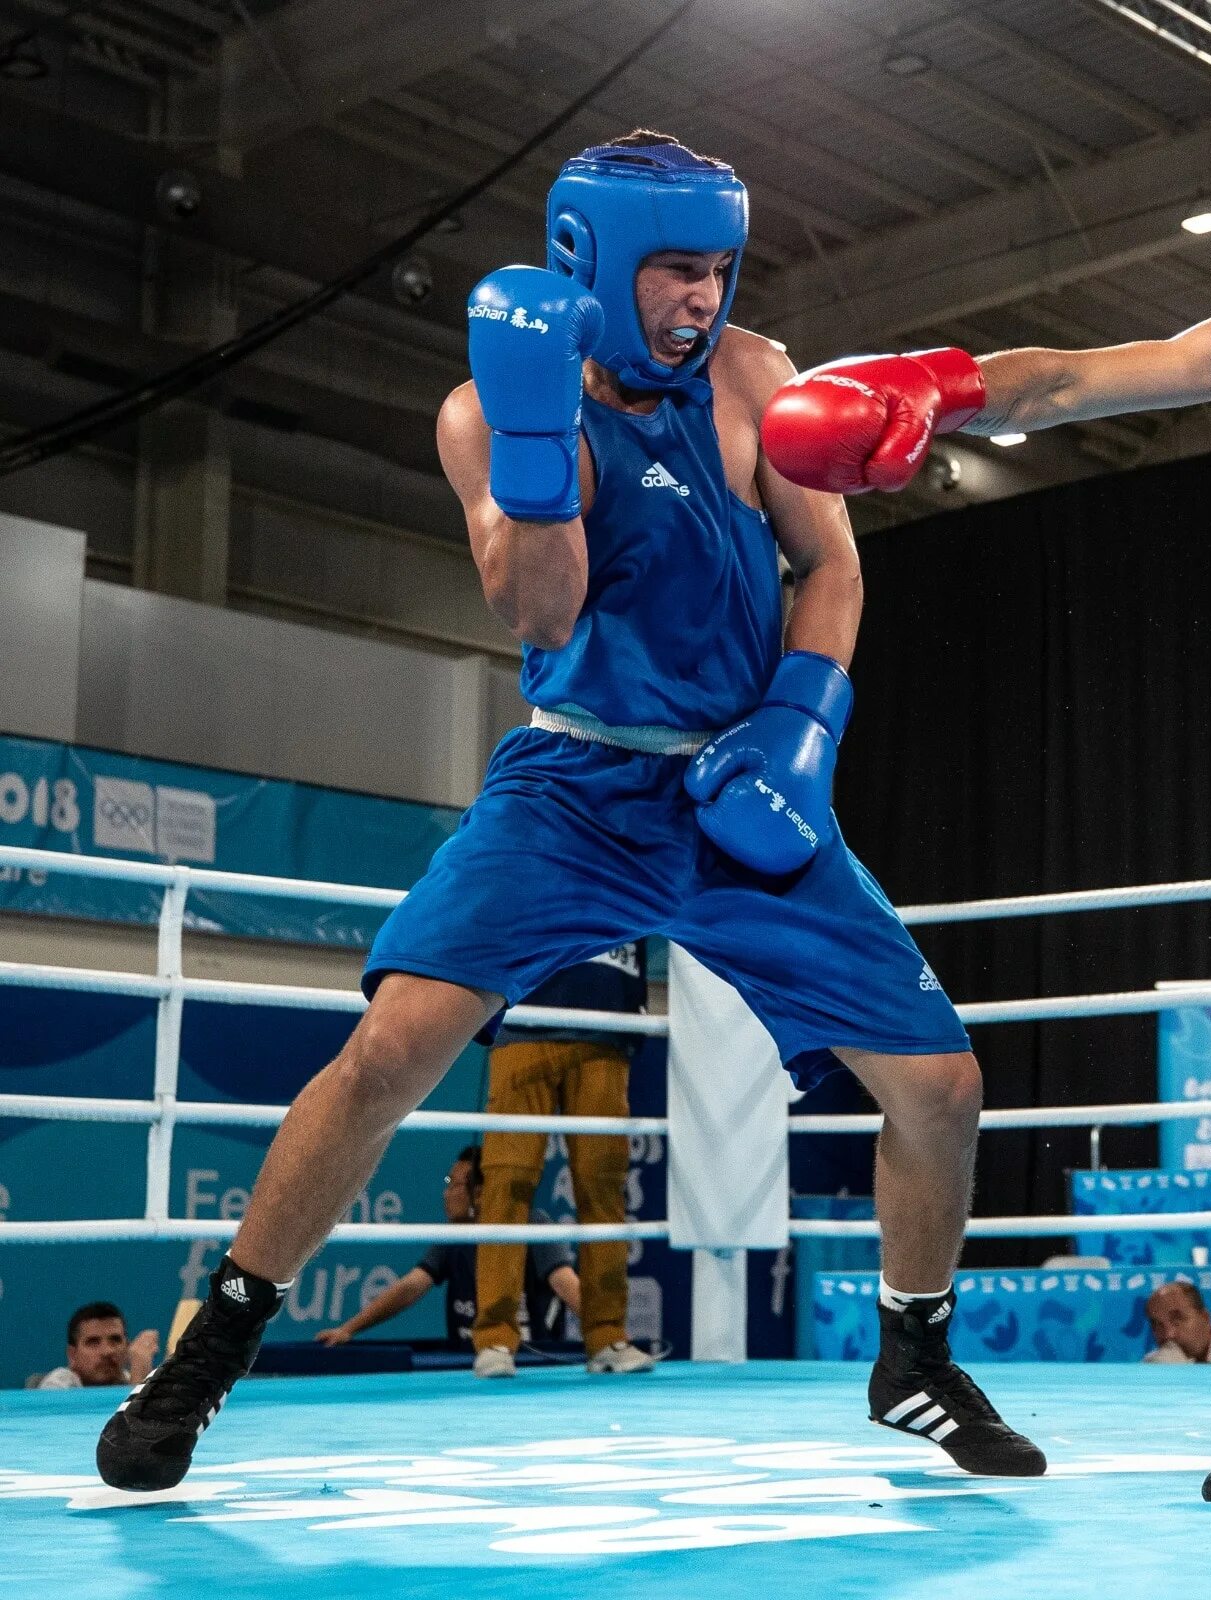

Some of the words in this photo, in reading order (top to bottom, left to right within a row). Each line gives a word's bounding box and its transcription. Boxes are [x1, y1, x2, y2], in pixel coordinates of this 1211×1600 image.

[714, 721, 752, 745] TaiShan
[785, 807, 819, 848] TaiShan
[221, 1283, 250, 1304] adidas
